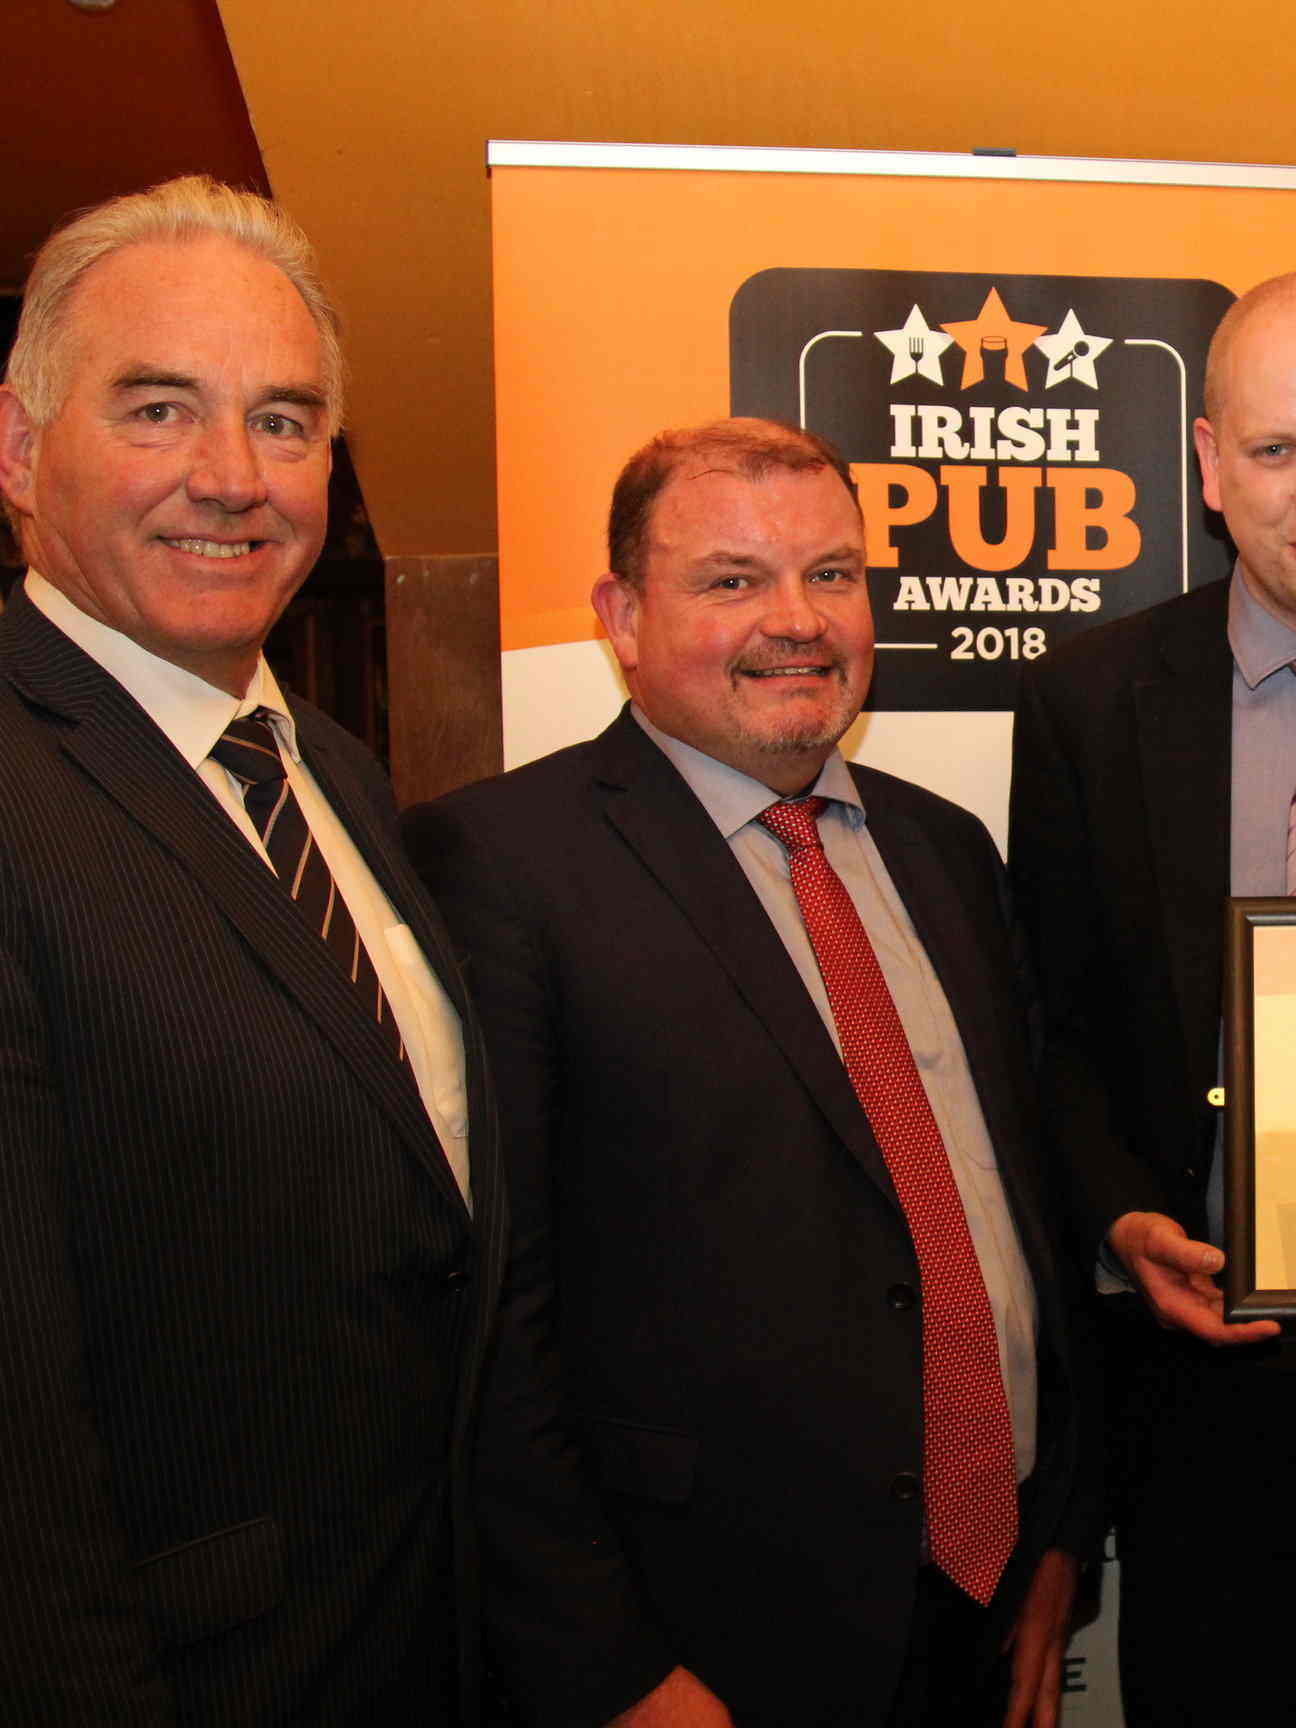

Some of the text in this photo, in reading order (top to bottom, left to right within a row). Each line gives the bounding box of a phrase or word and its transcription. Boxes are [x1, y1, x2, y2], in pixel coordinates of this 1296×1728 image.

[890, 404, 1100, 462] IRISH
[850, 462, 1142, 572] PUB
[893, 576, 1101, 613] AWARDS
[950, 626, 1047, 661] 2018
